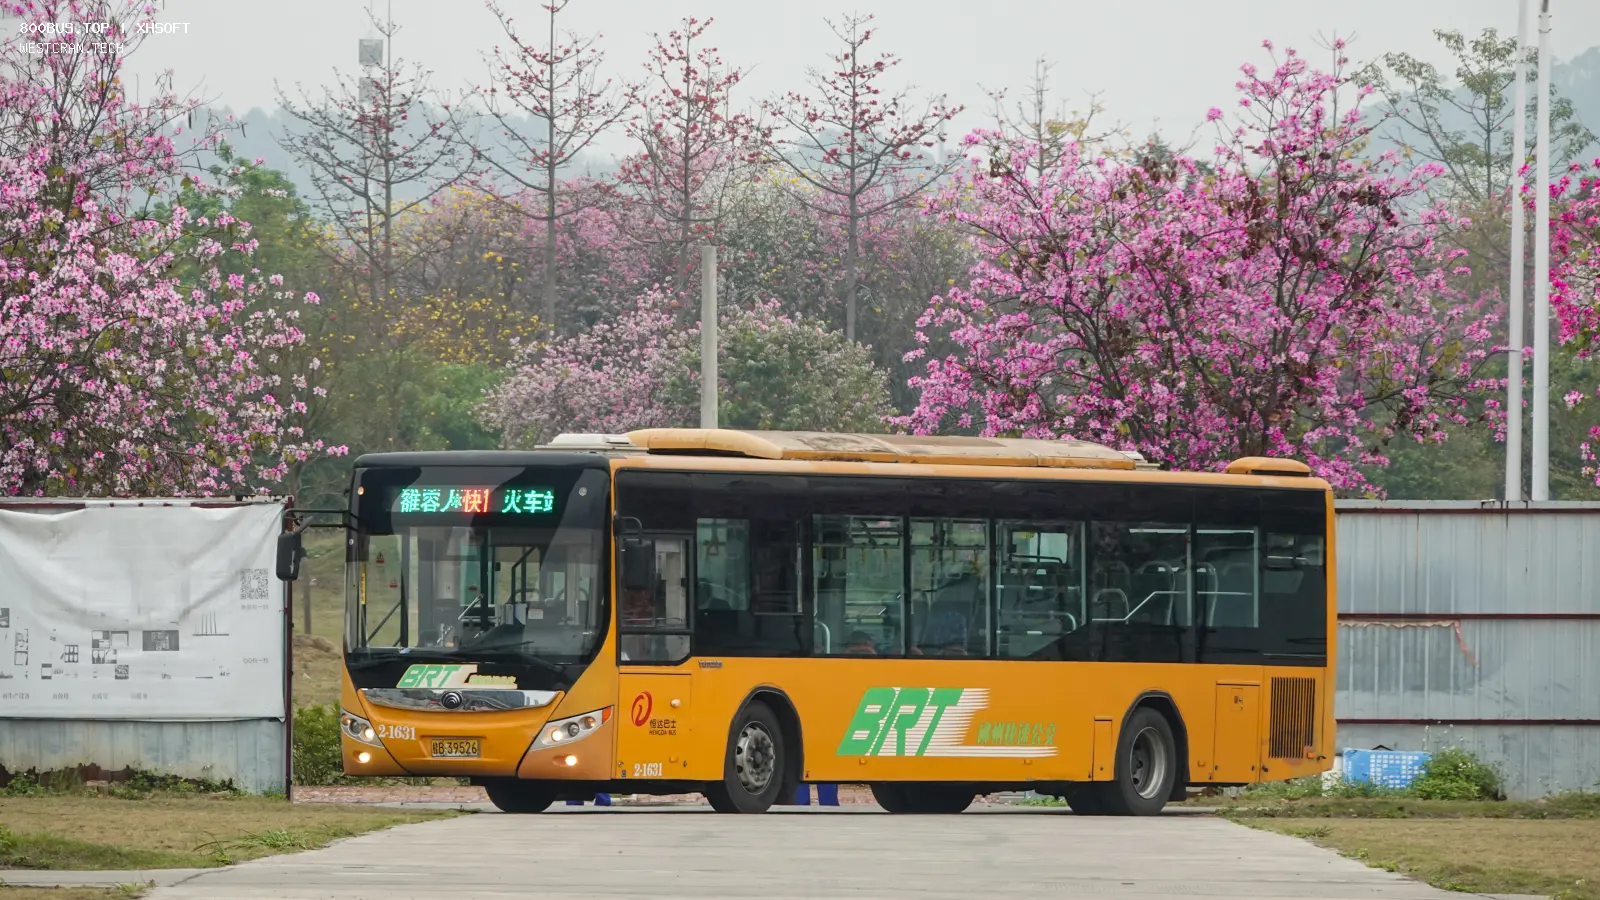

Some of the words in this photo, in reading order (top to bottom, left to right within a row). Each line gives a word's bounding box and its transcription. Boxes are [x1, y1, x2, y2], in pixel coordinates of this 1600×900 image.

[396, 664, 463, 688] BRT
[836, 687, 966, 756] BRT
[378, 724, 416, 740] 2-1631
[633, 762, 663, 777] 2-1631
